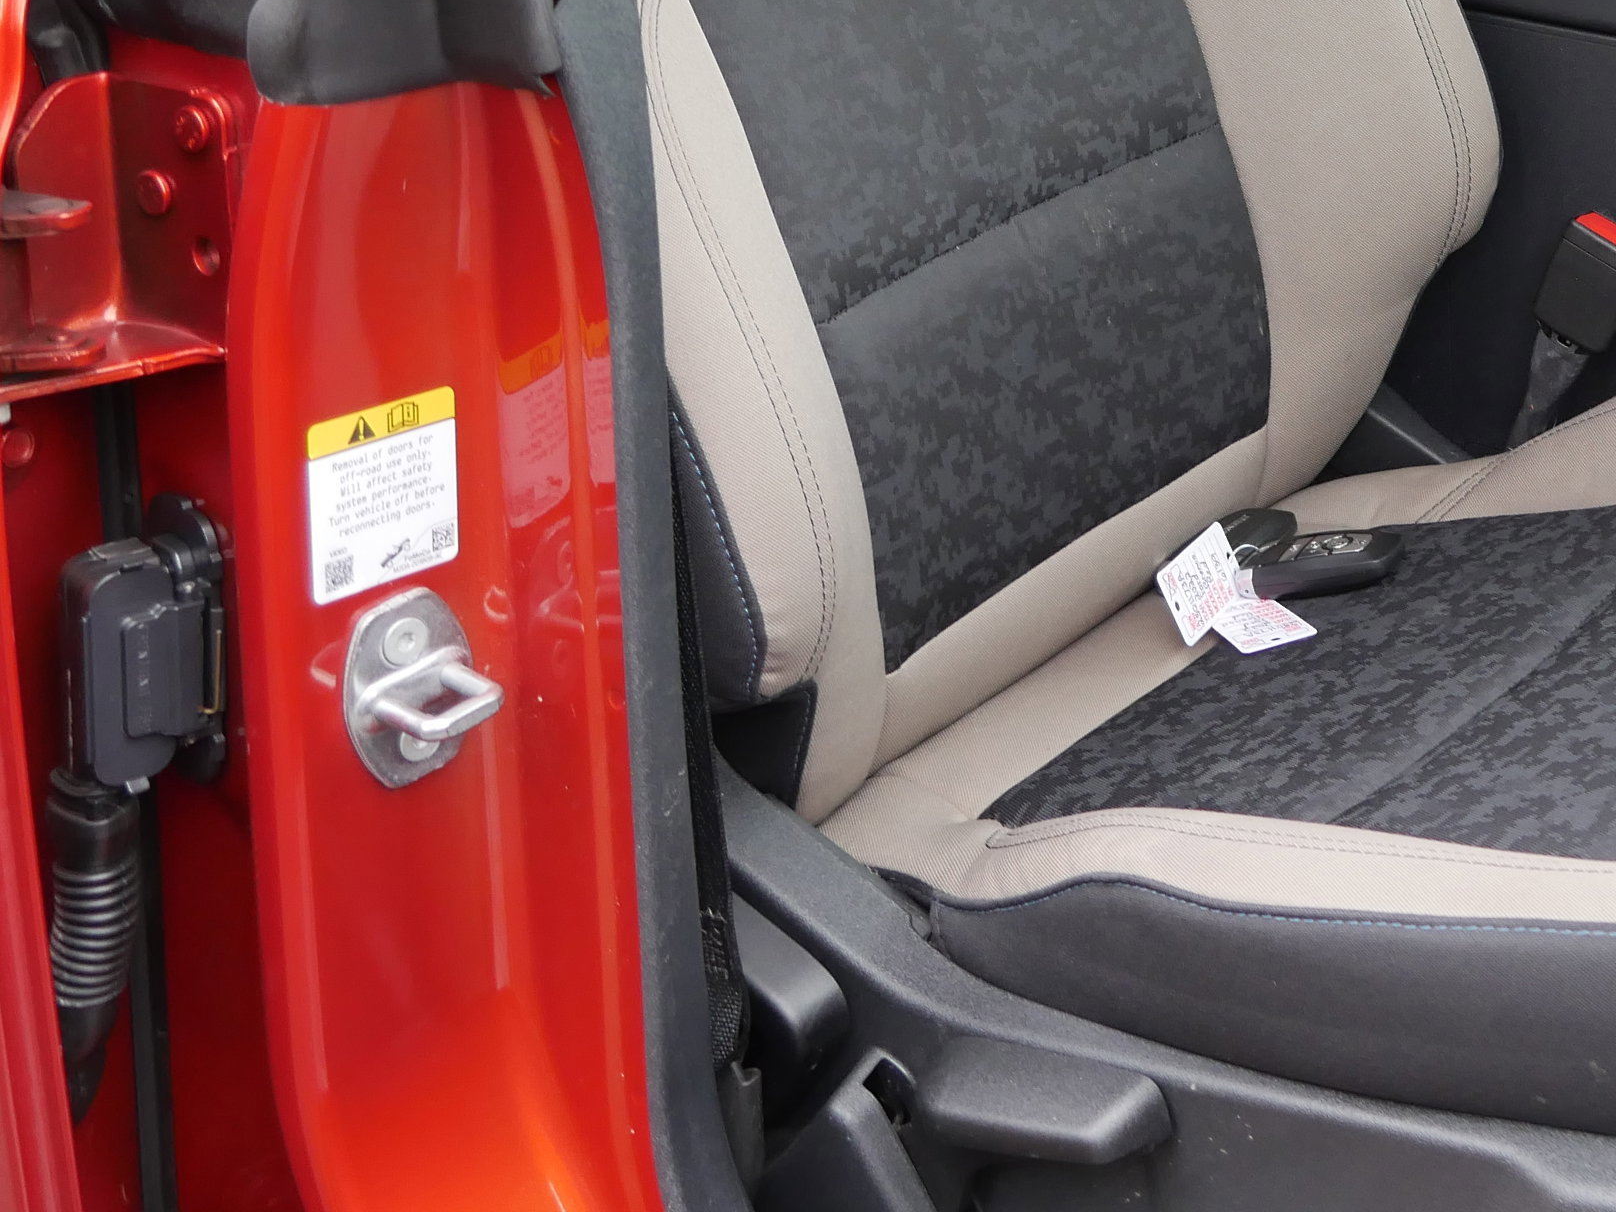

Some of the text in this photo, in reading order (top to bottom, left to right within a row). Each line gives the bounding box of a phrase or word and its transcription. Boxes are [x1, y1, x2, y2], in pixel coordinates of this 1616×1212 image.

[331, 434, 433, 473] Removal of doors for
[340, 463, 382, 484] off-road
[386, 458, 402, 470] use
[340, 461, 433, 497] Will affect safety
[329, 483, 445, 528] Turn vehicle off before
[336, 495, 367, 513] system
[339, 510, 401, 538] reconnecting
